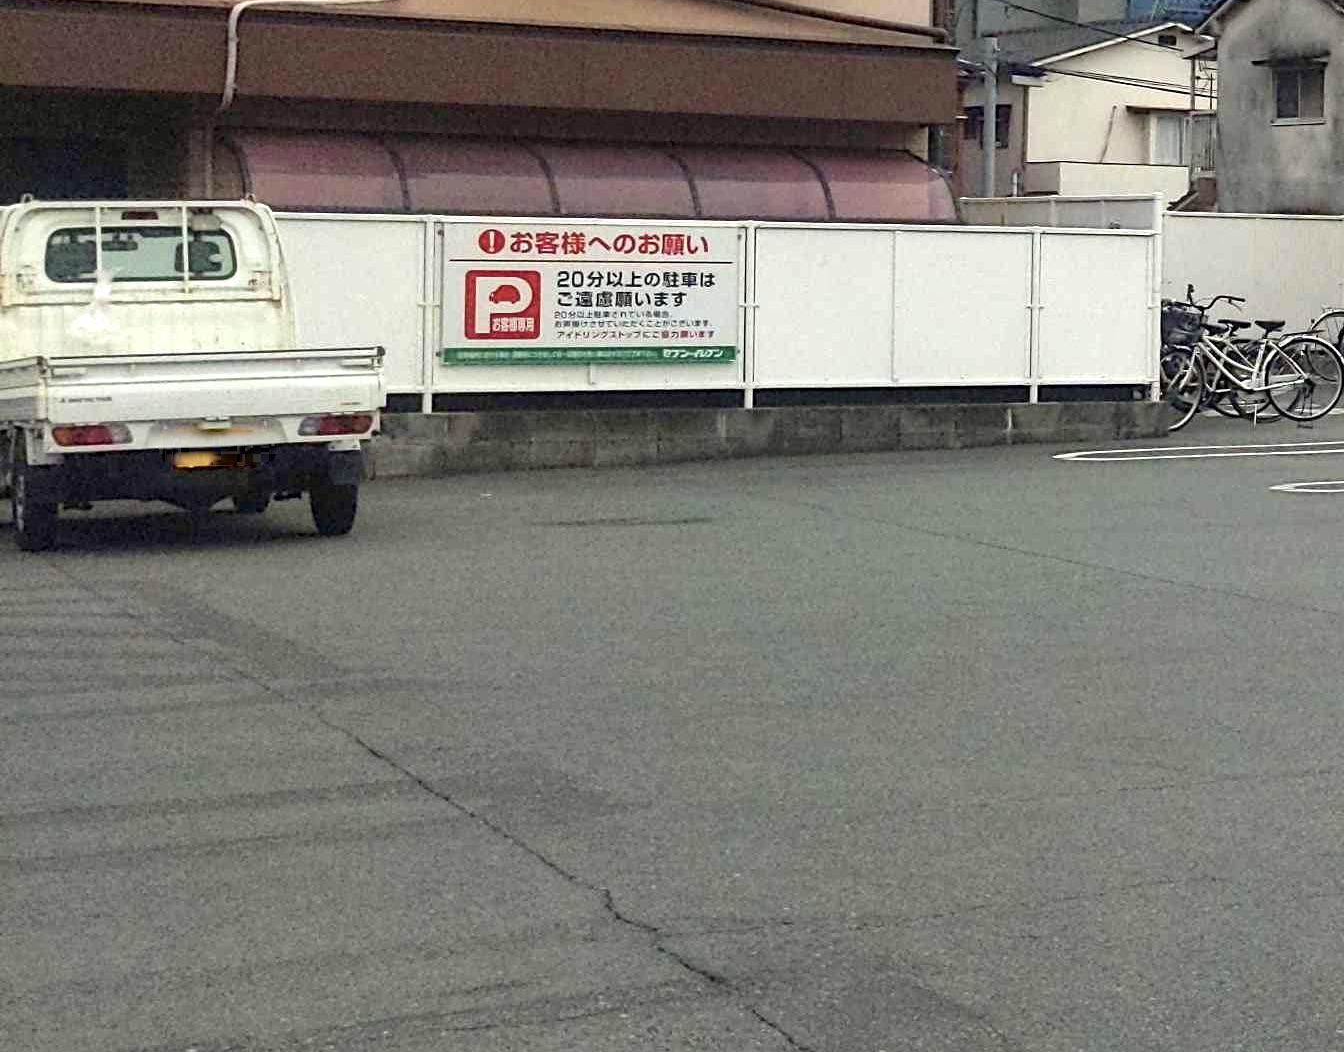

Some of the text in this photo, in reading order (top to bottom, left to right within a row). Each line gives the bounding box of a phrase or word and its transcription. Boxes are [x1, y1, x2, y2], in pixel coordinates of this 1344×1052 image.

[510, 231, 709, 256] お客様へのお願い
[556, 270, 716, 288] 20分以上の駐車は
[557, 291, 687, 308] ご遠慮願います
